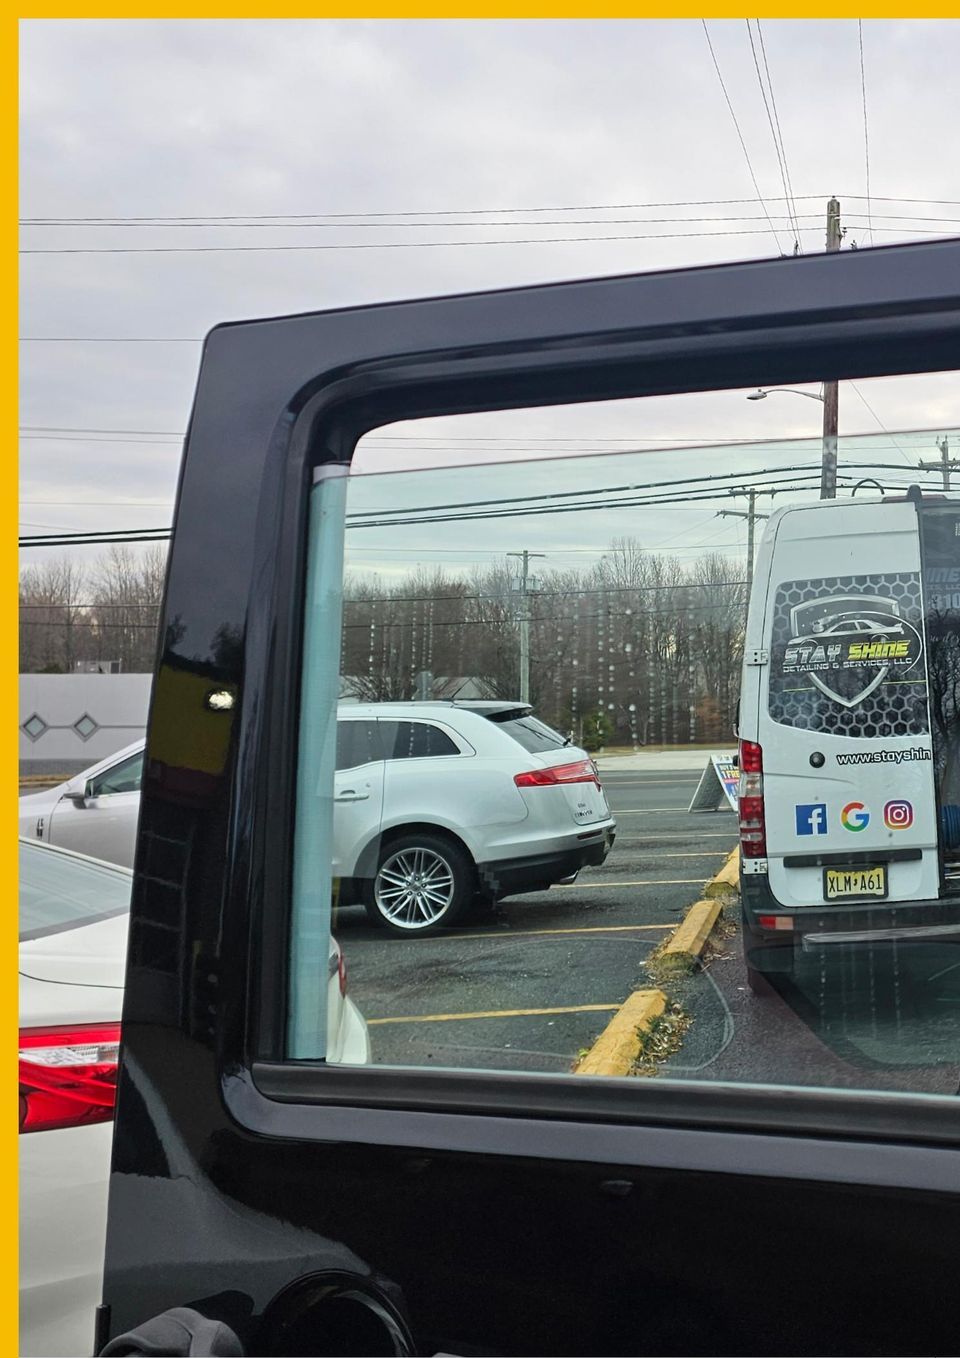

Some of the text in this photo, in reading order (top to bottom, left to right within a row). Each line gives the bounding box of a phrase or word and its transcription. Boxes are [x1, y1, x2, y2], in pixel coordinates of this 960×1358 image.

[783, 639, 912, 665] STAY SHINE
[783, 663, 829, 673] DETAILING
[894, 657, 913, 665] LLC
